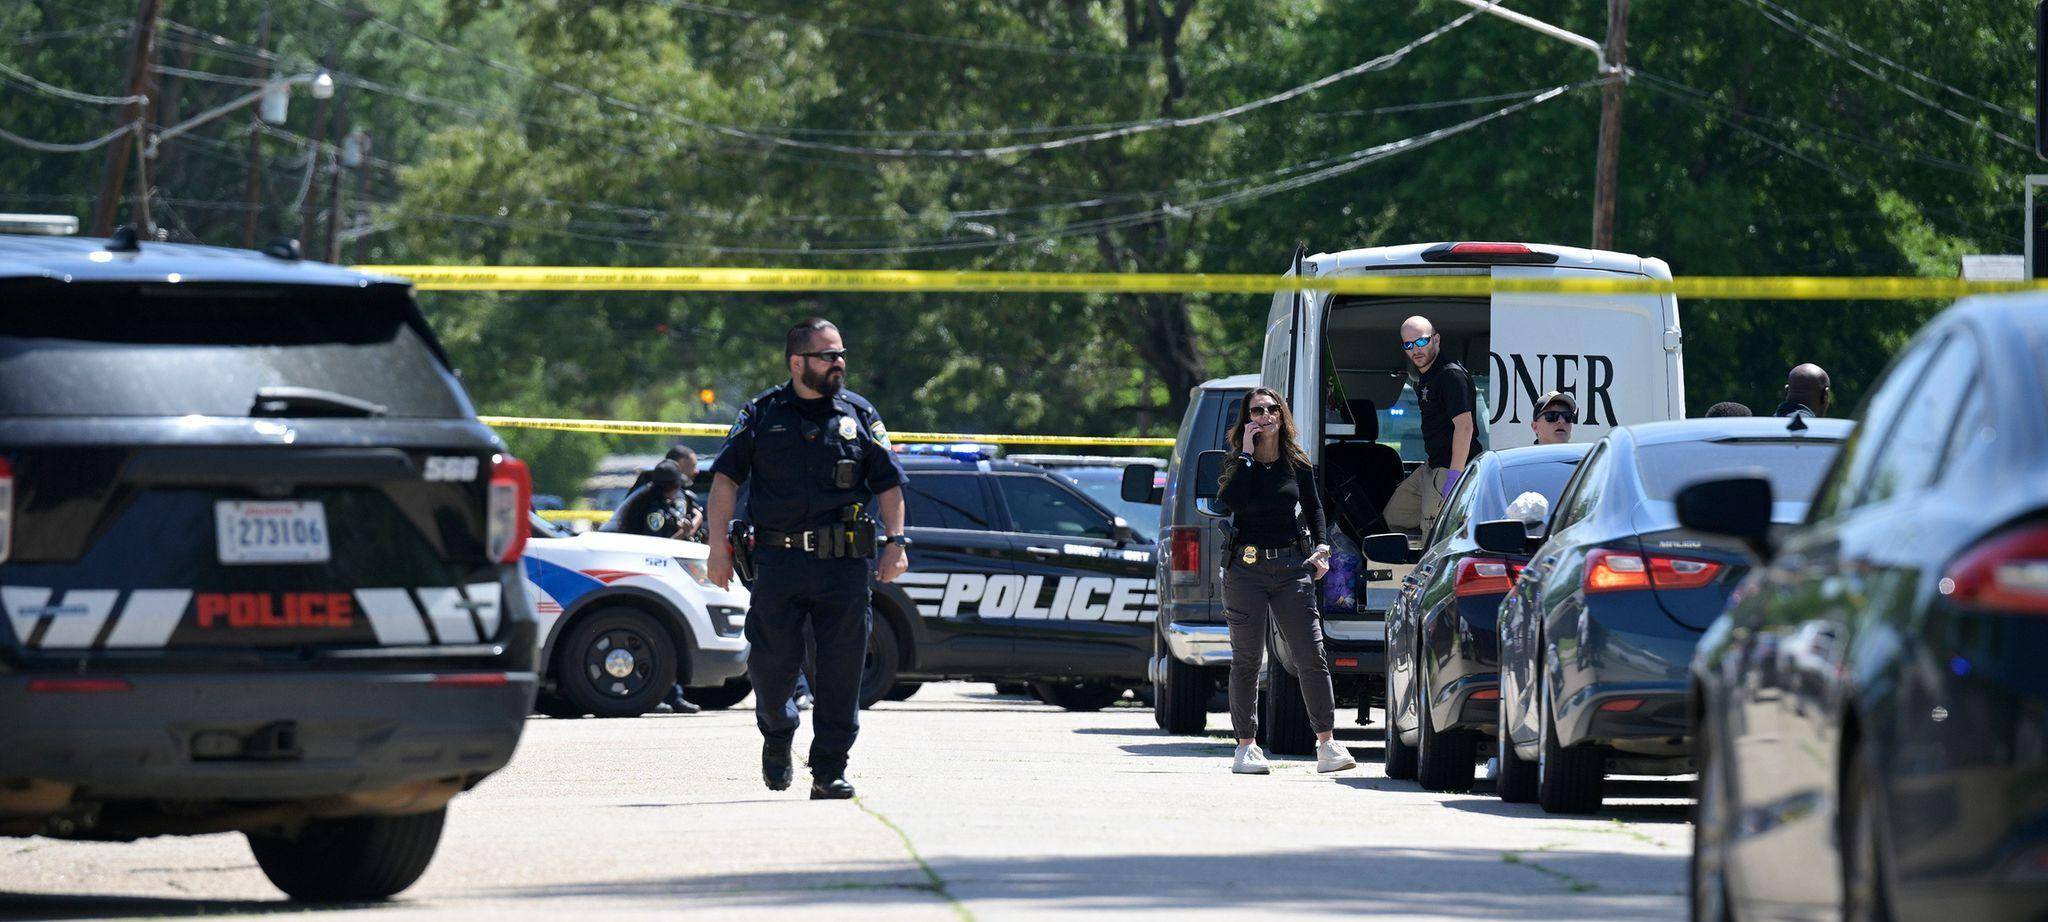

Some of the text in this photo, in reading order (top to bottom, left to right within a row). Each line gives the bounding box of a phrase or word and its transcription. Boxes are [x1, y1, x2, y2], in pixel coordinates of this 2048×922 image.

[240, 518, 322, 545] 273106
[645, 557, 667, 567] 521
[196, 592, 353, 629] POLICE
[939, 573, 1148, 622] POLICE
